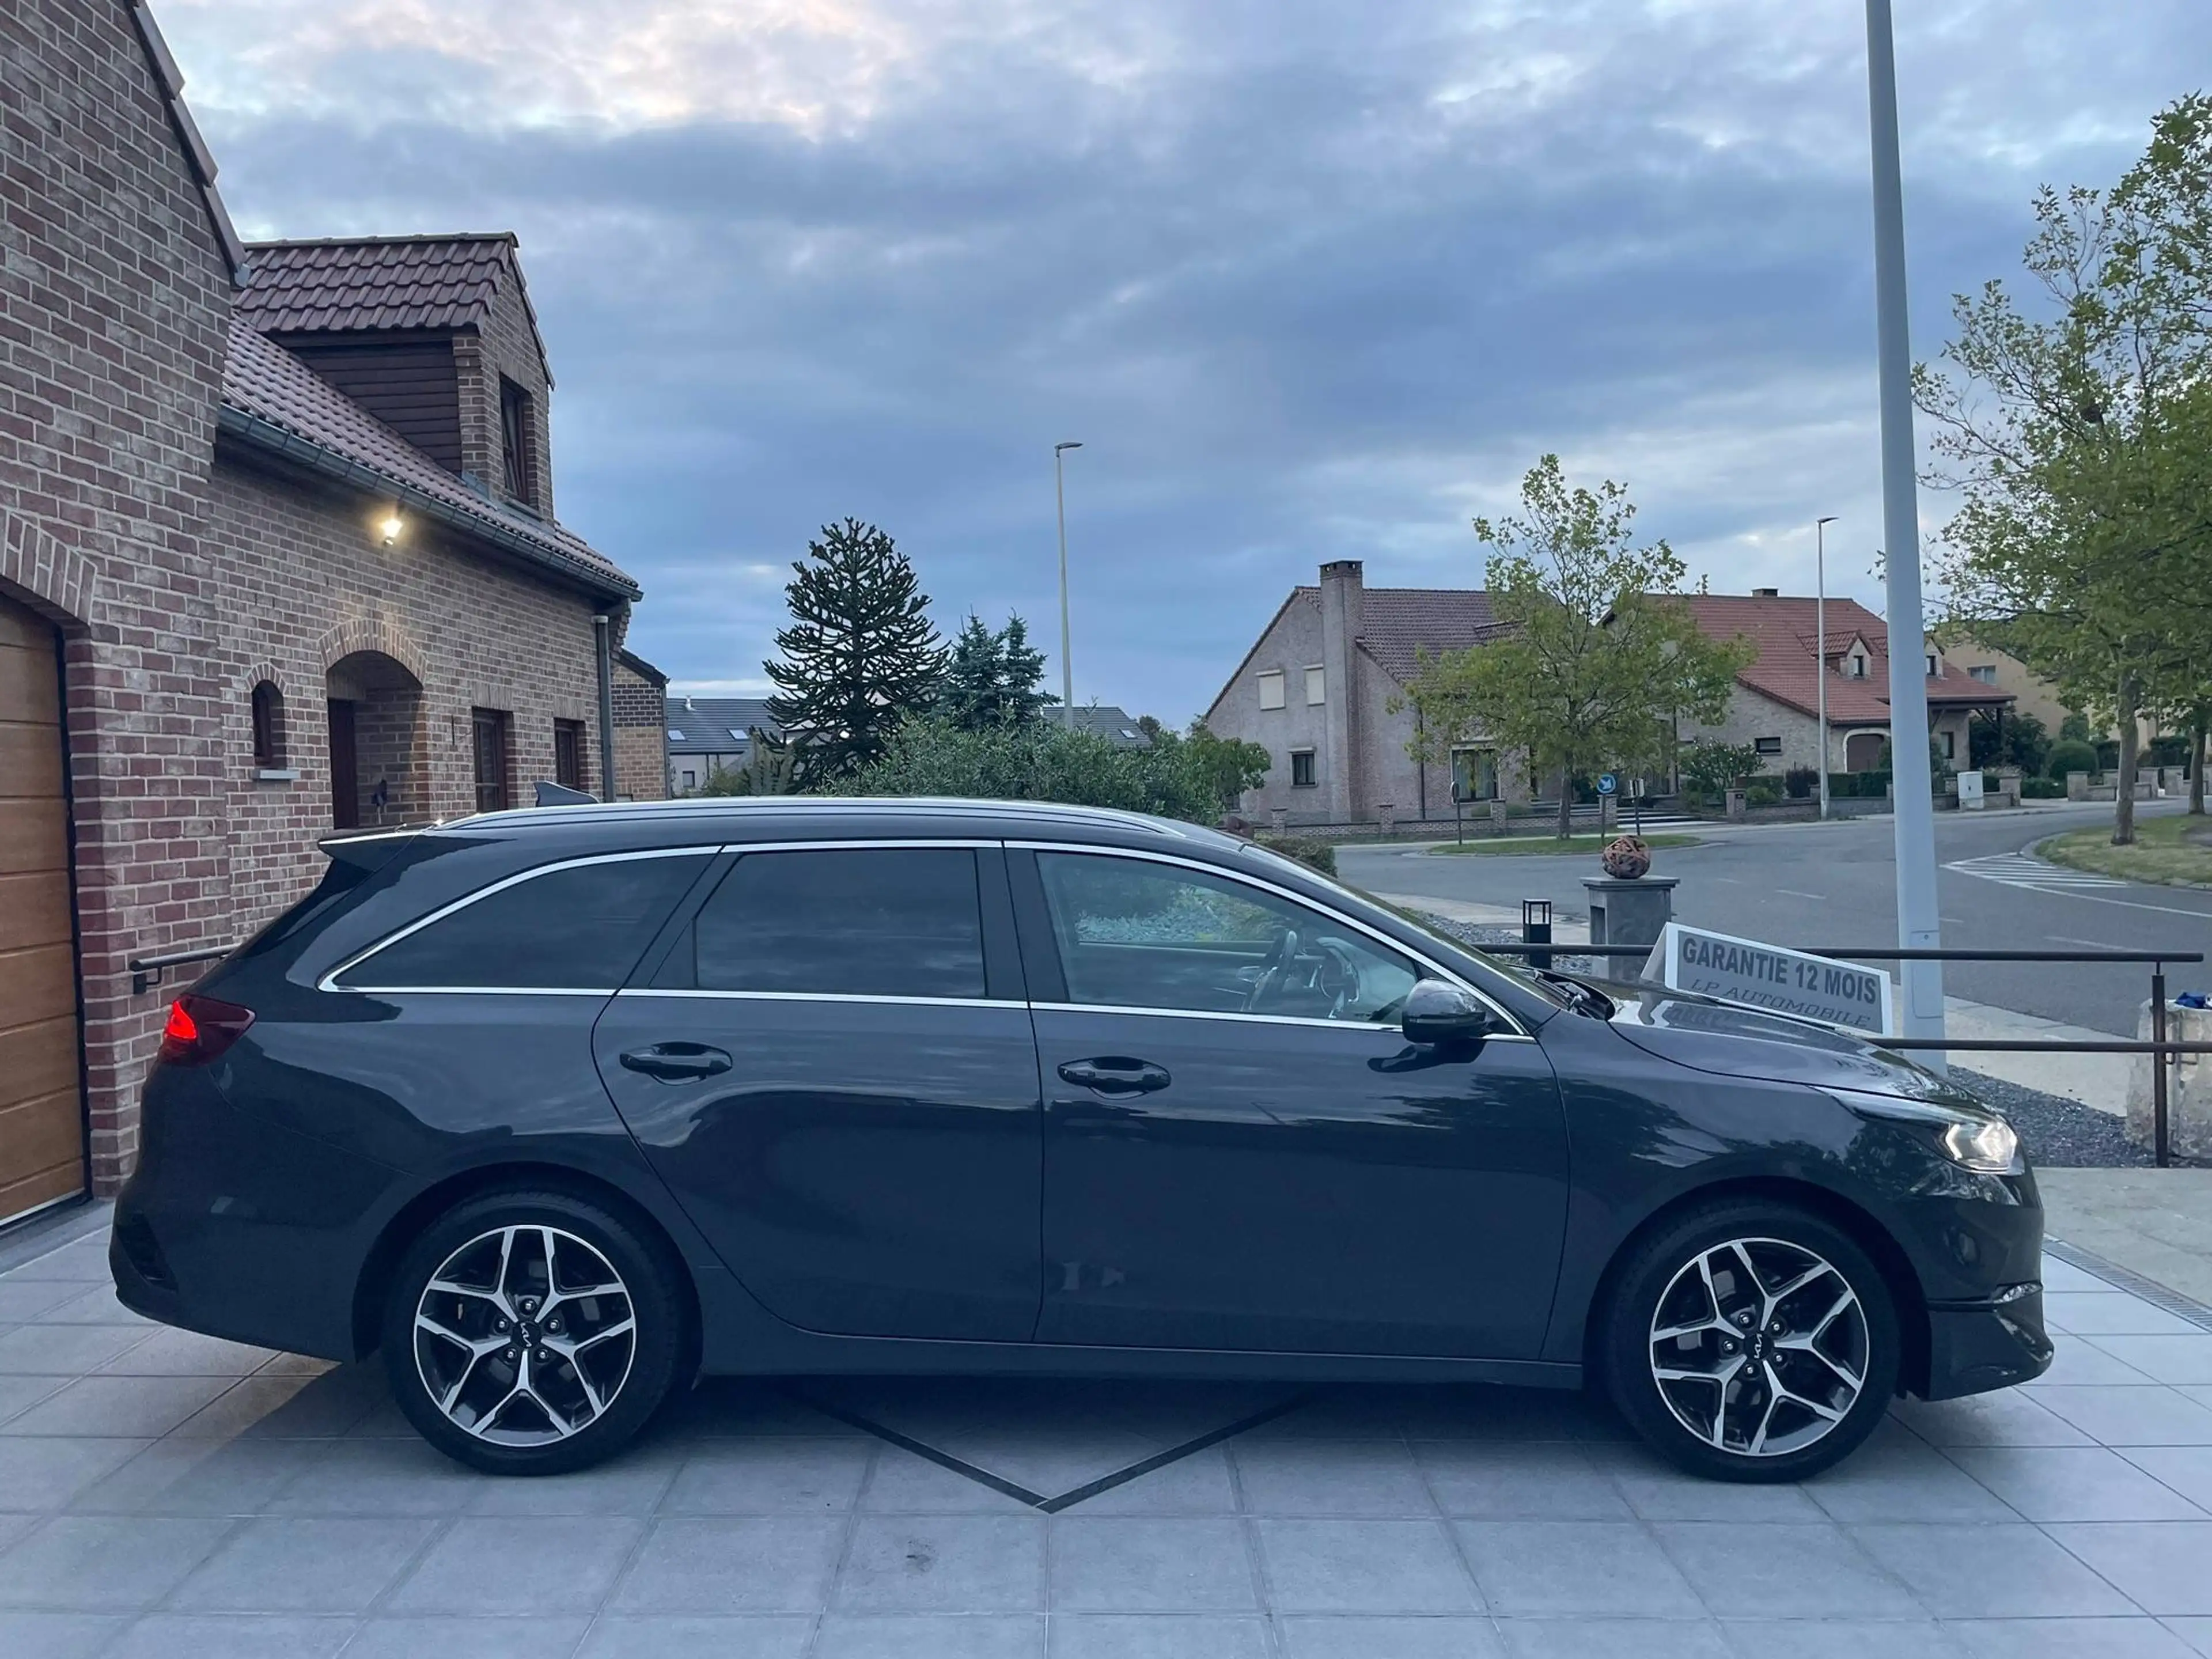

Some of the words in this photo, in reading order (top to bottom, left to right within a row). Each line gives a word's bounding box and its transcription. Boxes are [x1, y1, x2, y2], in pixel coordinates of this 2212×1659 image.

[1683, 937, 1788, 984] GARANTIE
[1796, 961, 1818, 991] 12
[1824, 968, 1876, 1005] MOIS
[1691, 978, 1720, 992] LP
[1722, 986, 1871, 1027] AUTOMOBILE
